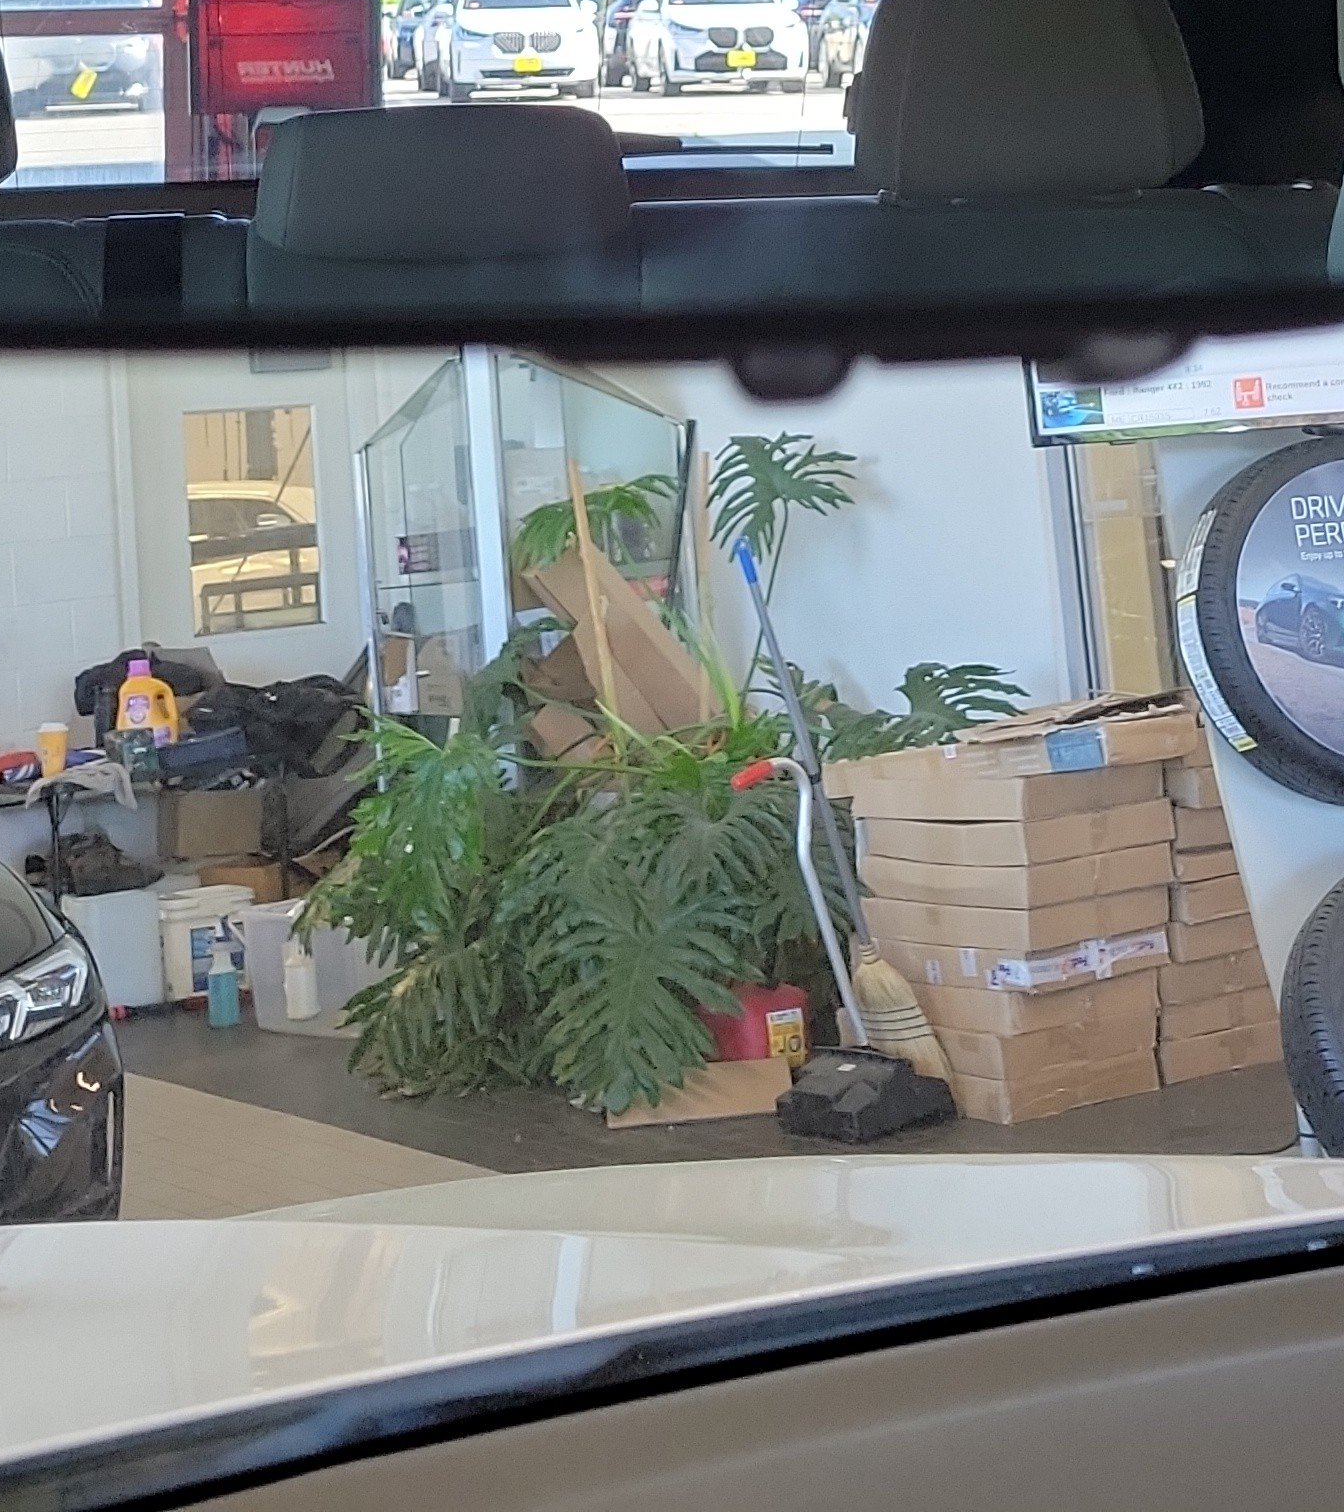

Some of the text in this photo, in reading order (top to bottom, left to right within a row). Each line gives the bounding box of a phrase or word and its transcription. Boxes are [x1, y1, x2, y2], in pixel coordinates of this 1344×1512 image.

[1266, 379, 1320, 391] Recommend
[1267, 393, 1292, 401] check
[1300, 550, 1322, 562] Enjoy
[1323, 551, 1333, 560] up
[1334, 549, 1343, 558] to
